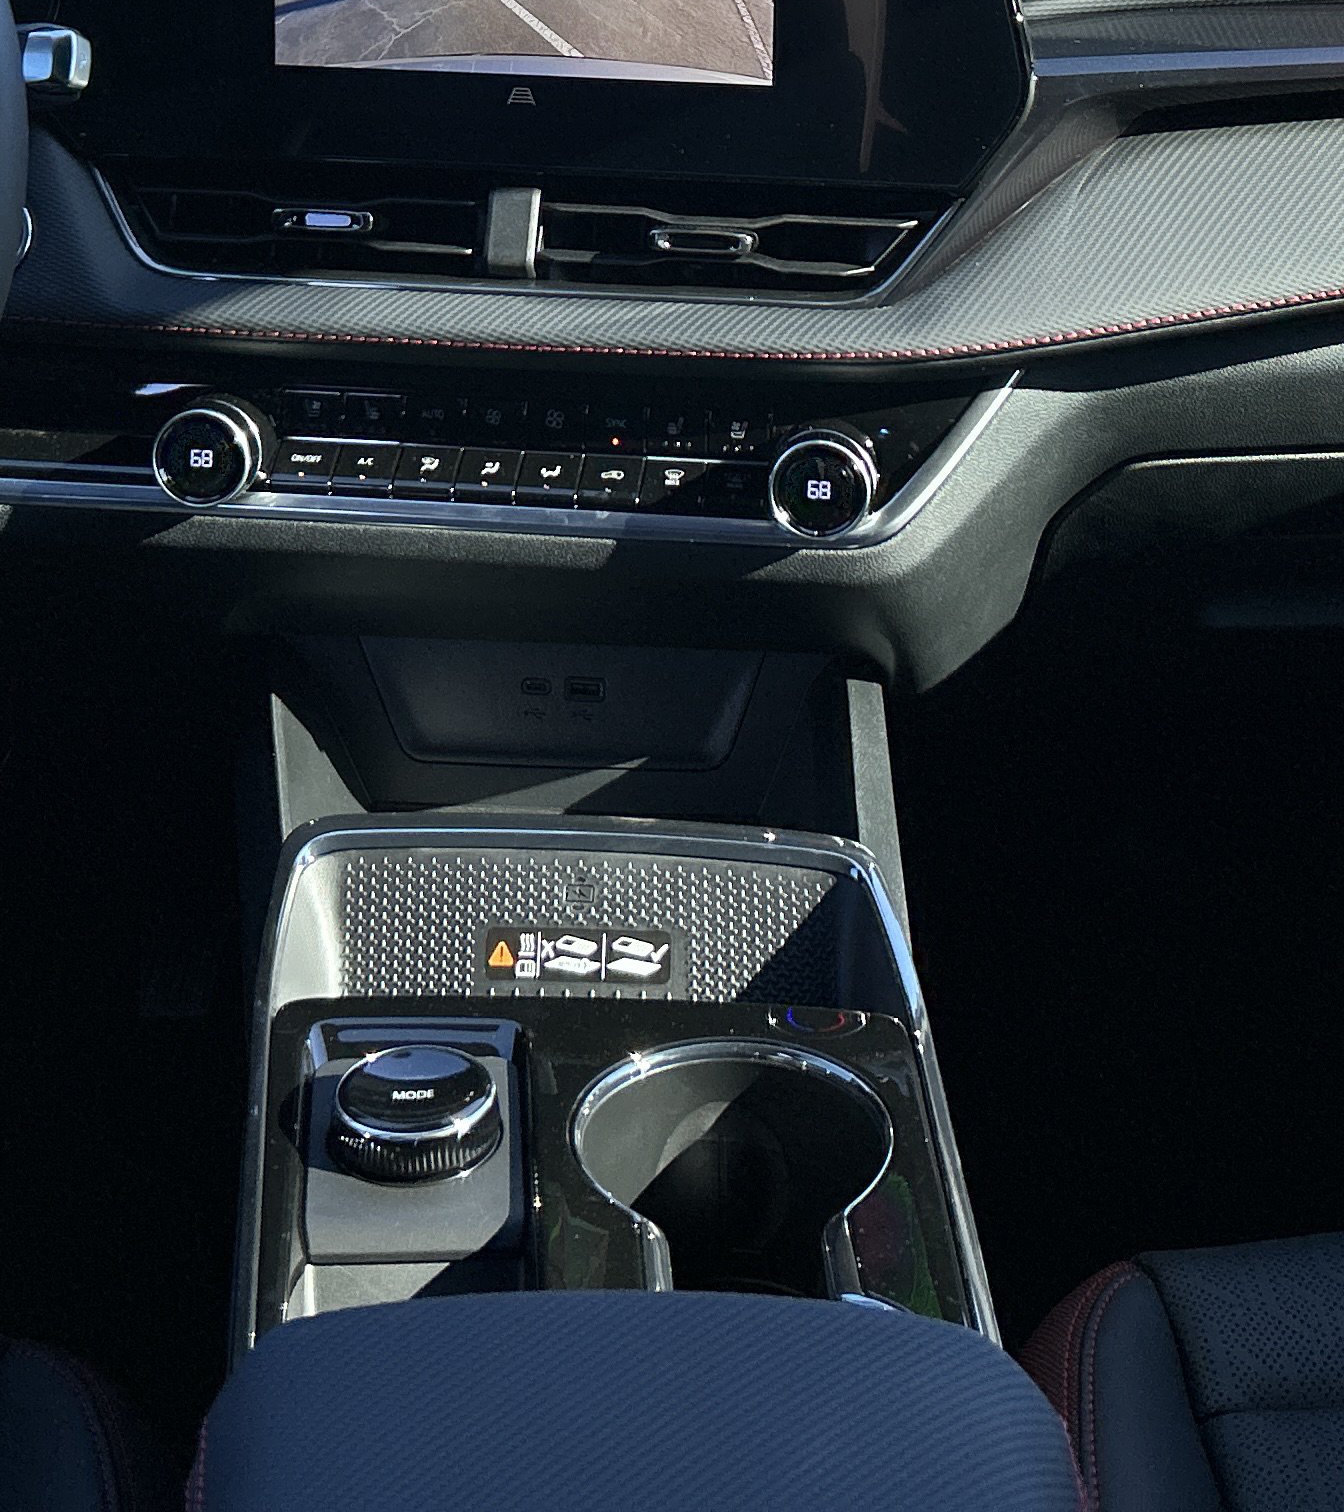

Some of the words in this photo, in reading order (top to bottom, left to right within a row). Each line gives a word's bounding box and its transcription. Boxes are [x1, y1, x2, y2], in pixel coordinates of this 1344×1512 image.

[189, 449, 213, 468] 68
[290, 452, 322, 464] ON/OFF
[357, 456, 374, 467] A/C
[806, 479, 831, 500] 68
[392, 1089, 434, 1100] MODE
